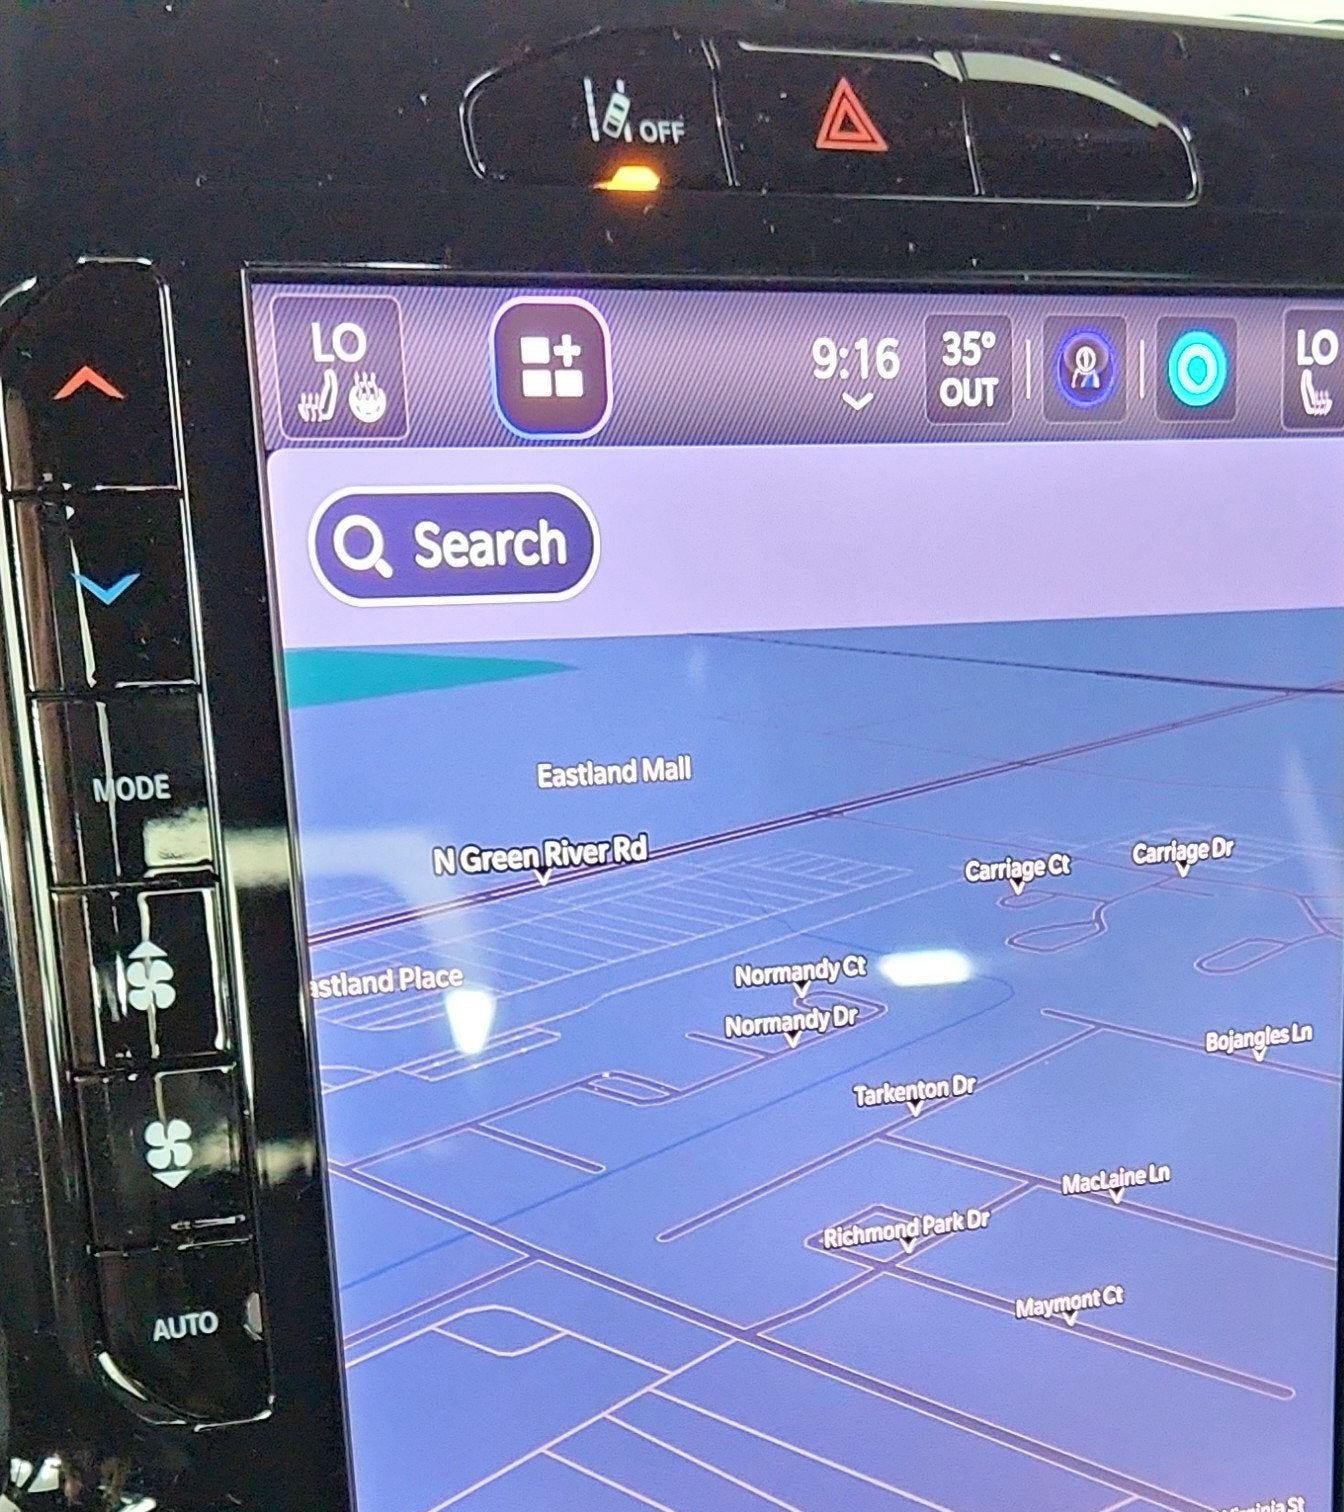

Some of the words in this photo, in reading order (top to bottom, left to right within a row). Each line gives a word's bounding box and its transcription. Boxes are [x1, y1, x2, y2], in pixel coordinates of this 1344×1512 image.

[639, 120, 685, 145] OFF
[311, 321, 367, 363] LO
[1296, 328, 1338, 367] LO
[812, 337, 900, 381] 9:16
[939, 377, 999, 409] OUT
[413, 518, 567, 568] Search
[537, 759, 637, 789] Eastland
[642, 755, 692, 783] Mall
[92, 774, 171, 803] MODE
[433, 847, 456, 876] N
[460, 842, 540, 875] Green
[543, 838, 610, 868] River
[613, 834, 648, 862] Rd
[964, 857, 1046, 883] Carriage
[1047, 854, 1071, 876] Ct
[1133, 843, 1209, 869] Carriage
[1212, 837, 1235, 859] Dr
[399, 966, 463, 991] Place
[735, 959, 841, 987] Normandy
[842, 956, 867, 977] Ct
[725, 1009, 831, 1038] Normandy
[833, 1006, 858, 1027] Dr
[1206, 1026, 1288, 1055] Bojangles
[1291, 1023, 1313, 1044] Ln
[854, 1080, 949, 1108] Tarkenton
[953, 1074, 976, 1096] Dr
[1062, 1168, 1147, 1195] MacLaine
[1150, 1164, 1170, 1183] Ln
[824, 1220, 920, 1249] Richmond
[923, 1213, 964, 1238] Park
[966, 1209, 990, 1230] Dr
[1016, 1289, 1100, 1320] Maymont
[1102, 1285, 1124, 1304] Ct
[153, 1310, 219, 1342] AUTO
